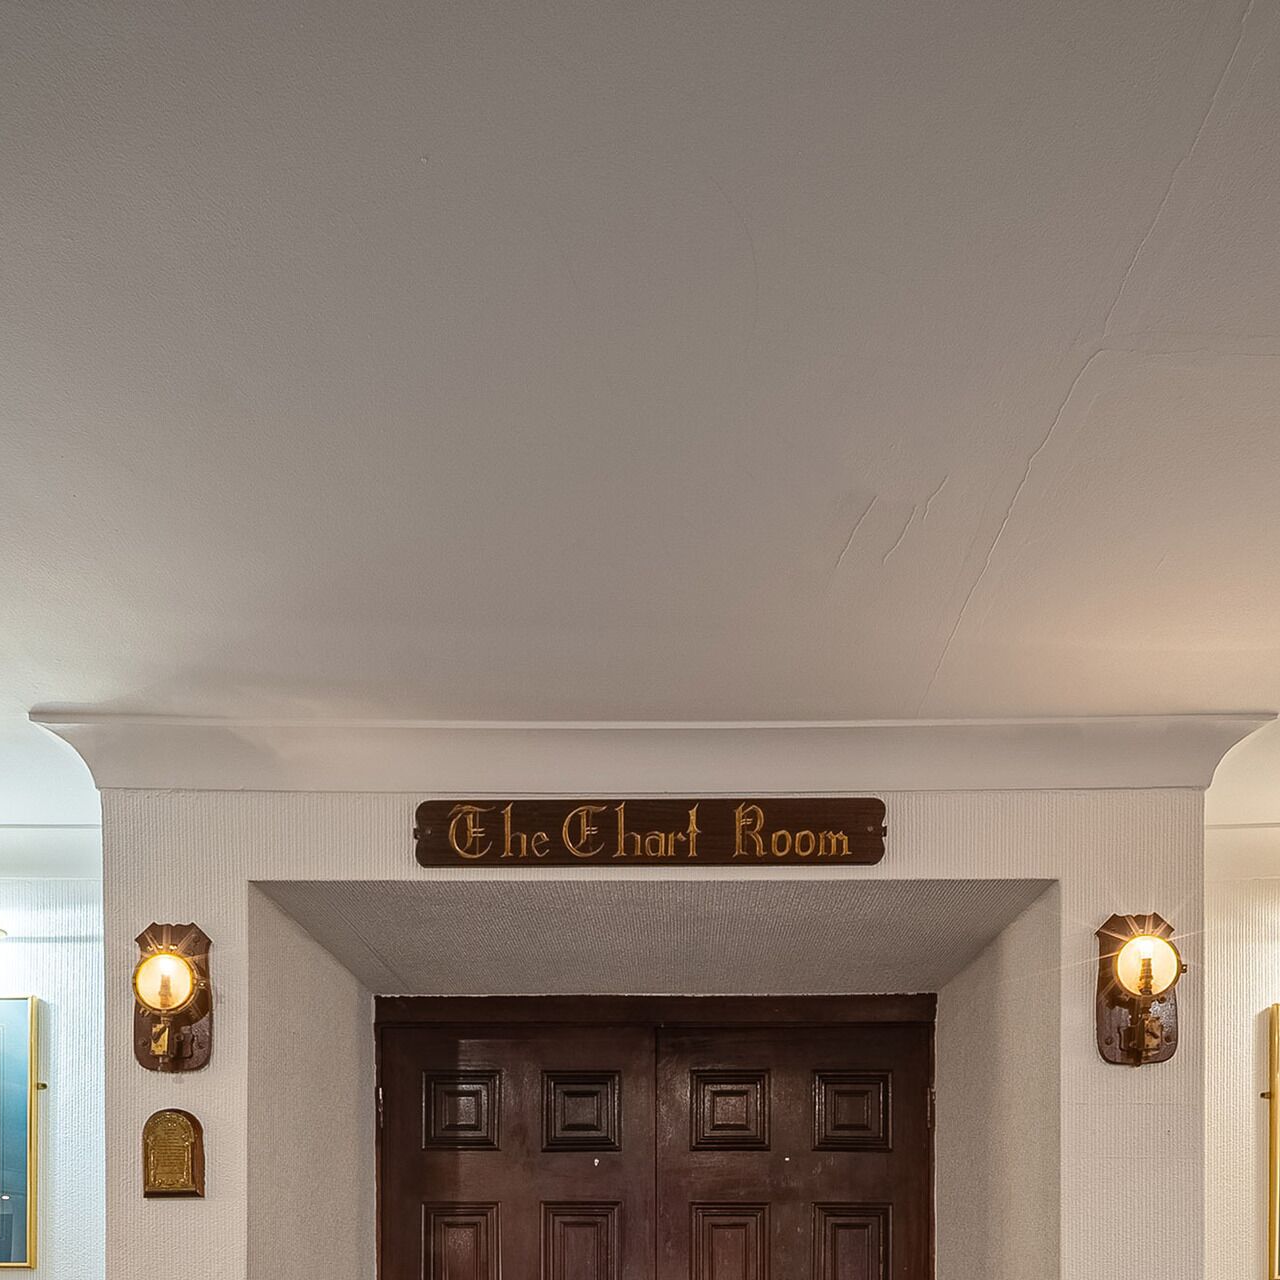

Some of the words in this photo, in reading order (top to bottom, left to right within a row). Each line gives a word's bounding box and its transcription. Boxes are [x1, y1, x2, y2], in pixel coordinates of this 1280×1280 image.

[448, 803, 551, 859] The
[562, 801, 702, 859] Chart
[732, 801, 854, 859] Room
